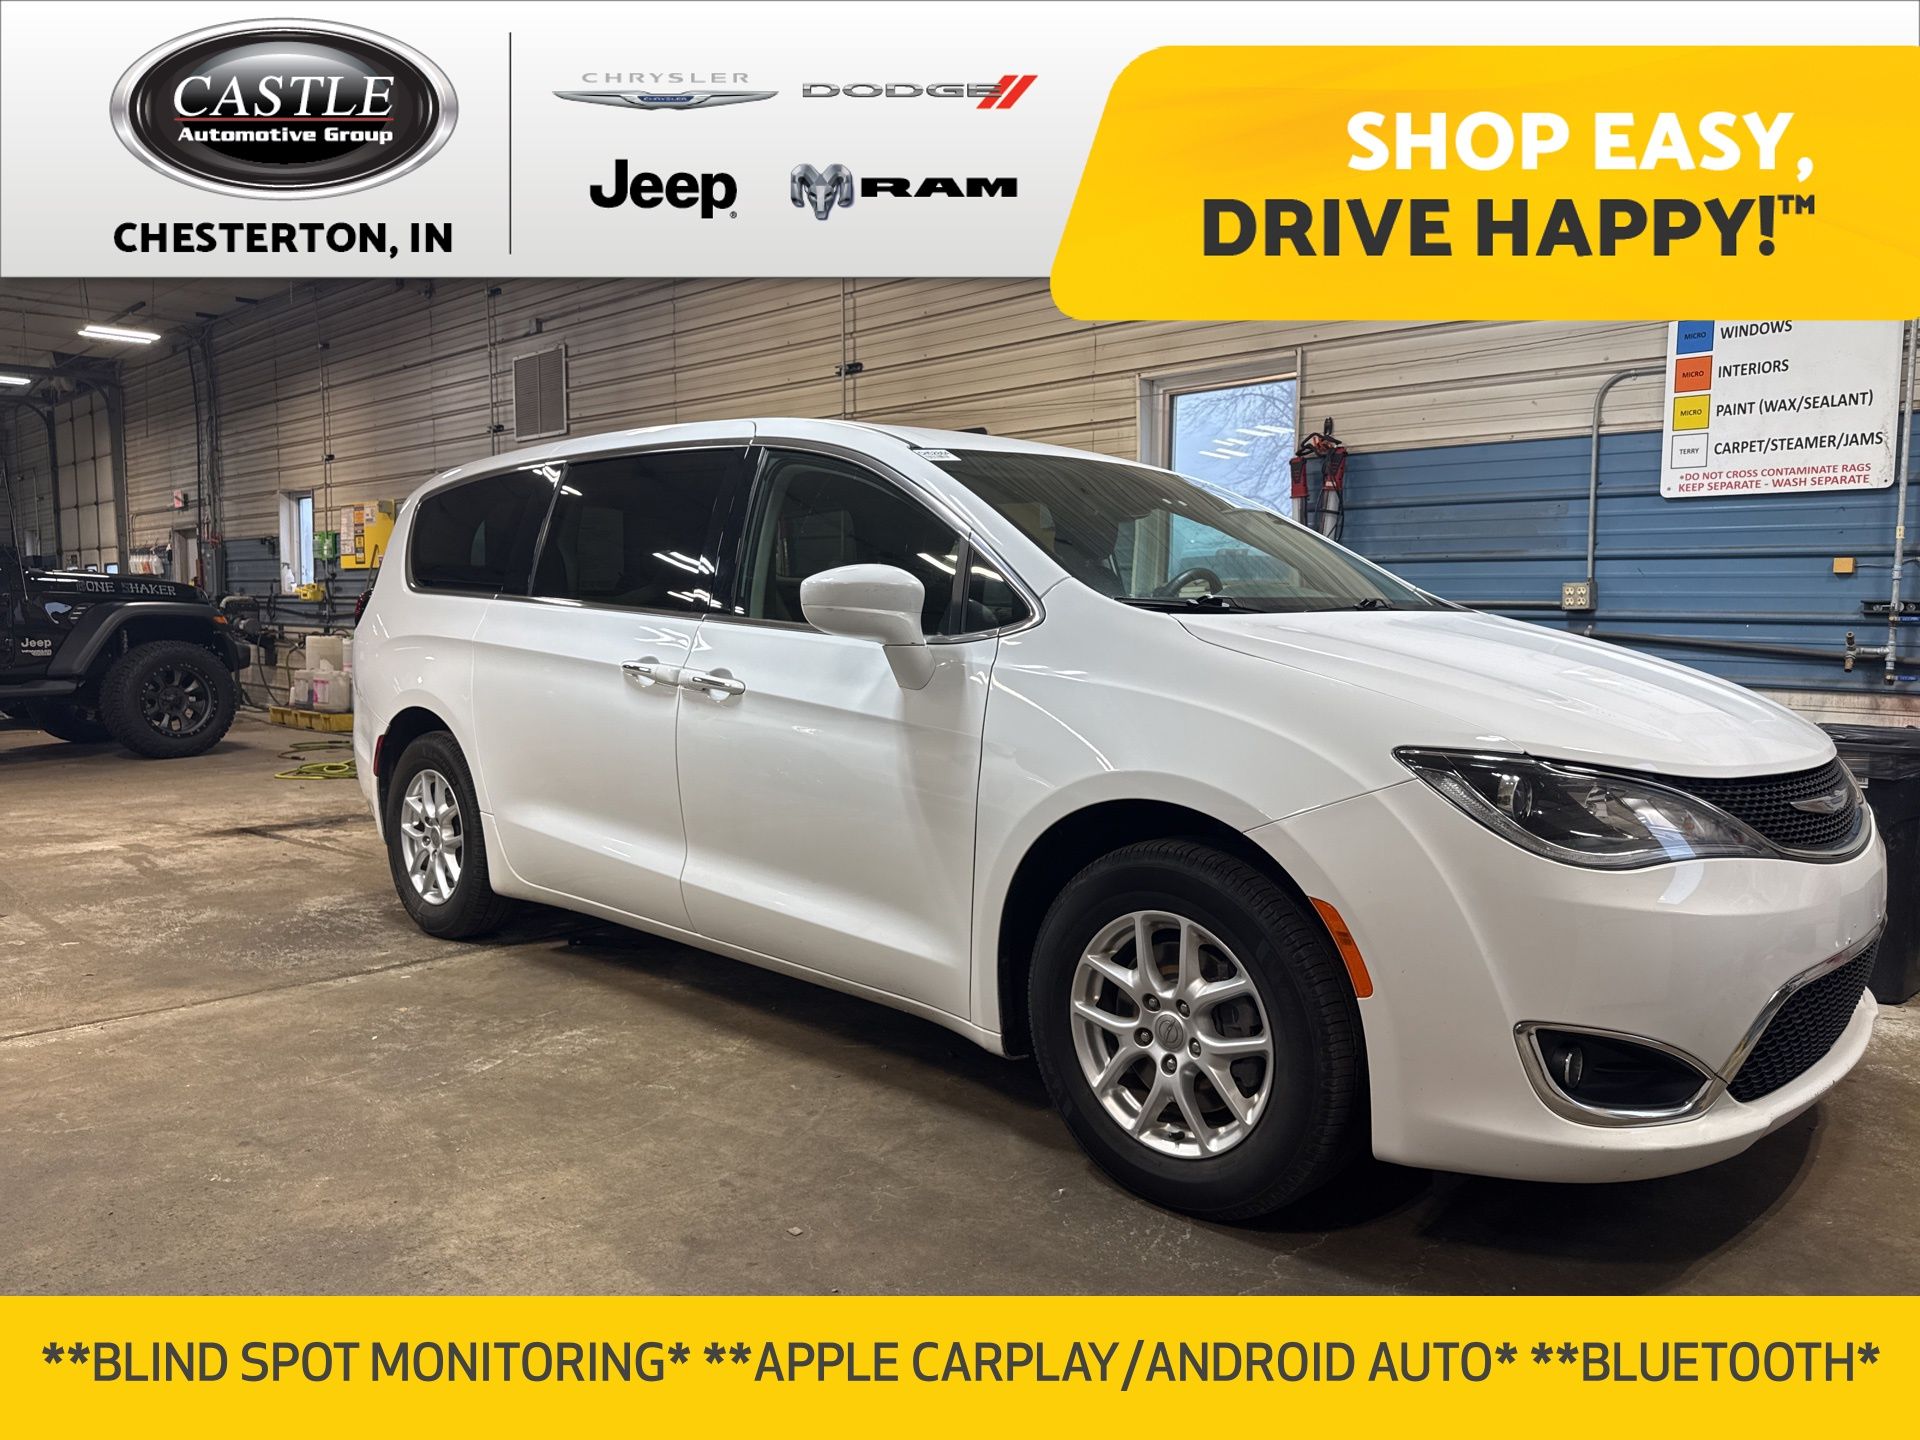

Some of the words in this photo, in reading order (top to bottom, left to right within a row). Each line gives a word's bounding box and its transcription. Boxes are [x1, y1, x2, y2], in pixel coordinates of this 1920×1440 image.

[1683, 331, 1707, 341] MICRO
[1720, 320, 1793, 340] WINDOWS
[1681, 370, 1705, 379] MICRO
[1718, 359, 1789, 378] INTERIORS
[1716, 401, 1756, 417] PAINT
[1759, 389, 1873, 415] (WAX/SEALANT)
[1680, 408, 1703, 417] MICRO
[1679, 447, 1700, 455] TERRY
[1714, 431, 1883, 455] CARPET/STEAMER/JAMS
[1702, 471, 1724, 481] NOT
[1726, 469, 1758, 479] CROSS
[1760, 464, 1839, 478] CONTAMINATE
[1841, 463, 1871, 473] RAGS
[1678, 482, 1705, 492] KEEP
[1707, 480, 1762, 491] SEPARATE
[1772, 477, 1807, 488] WASH
[1810, 474, 1870, 486] SEPARATE
[121, 582, 176, 596] SHAKER
[21, 638, 52, 648] Jeep
